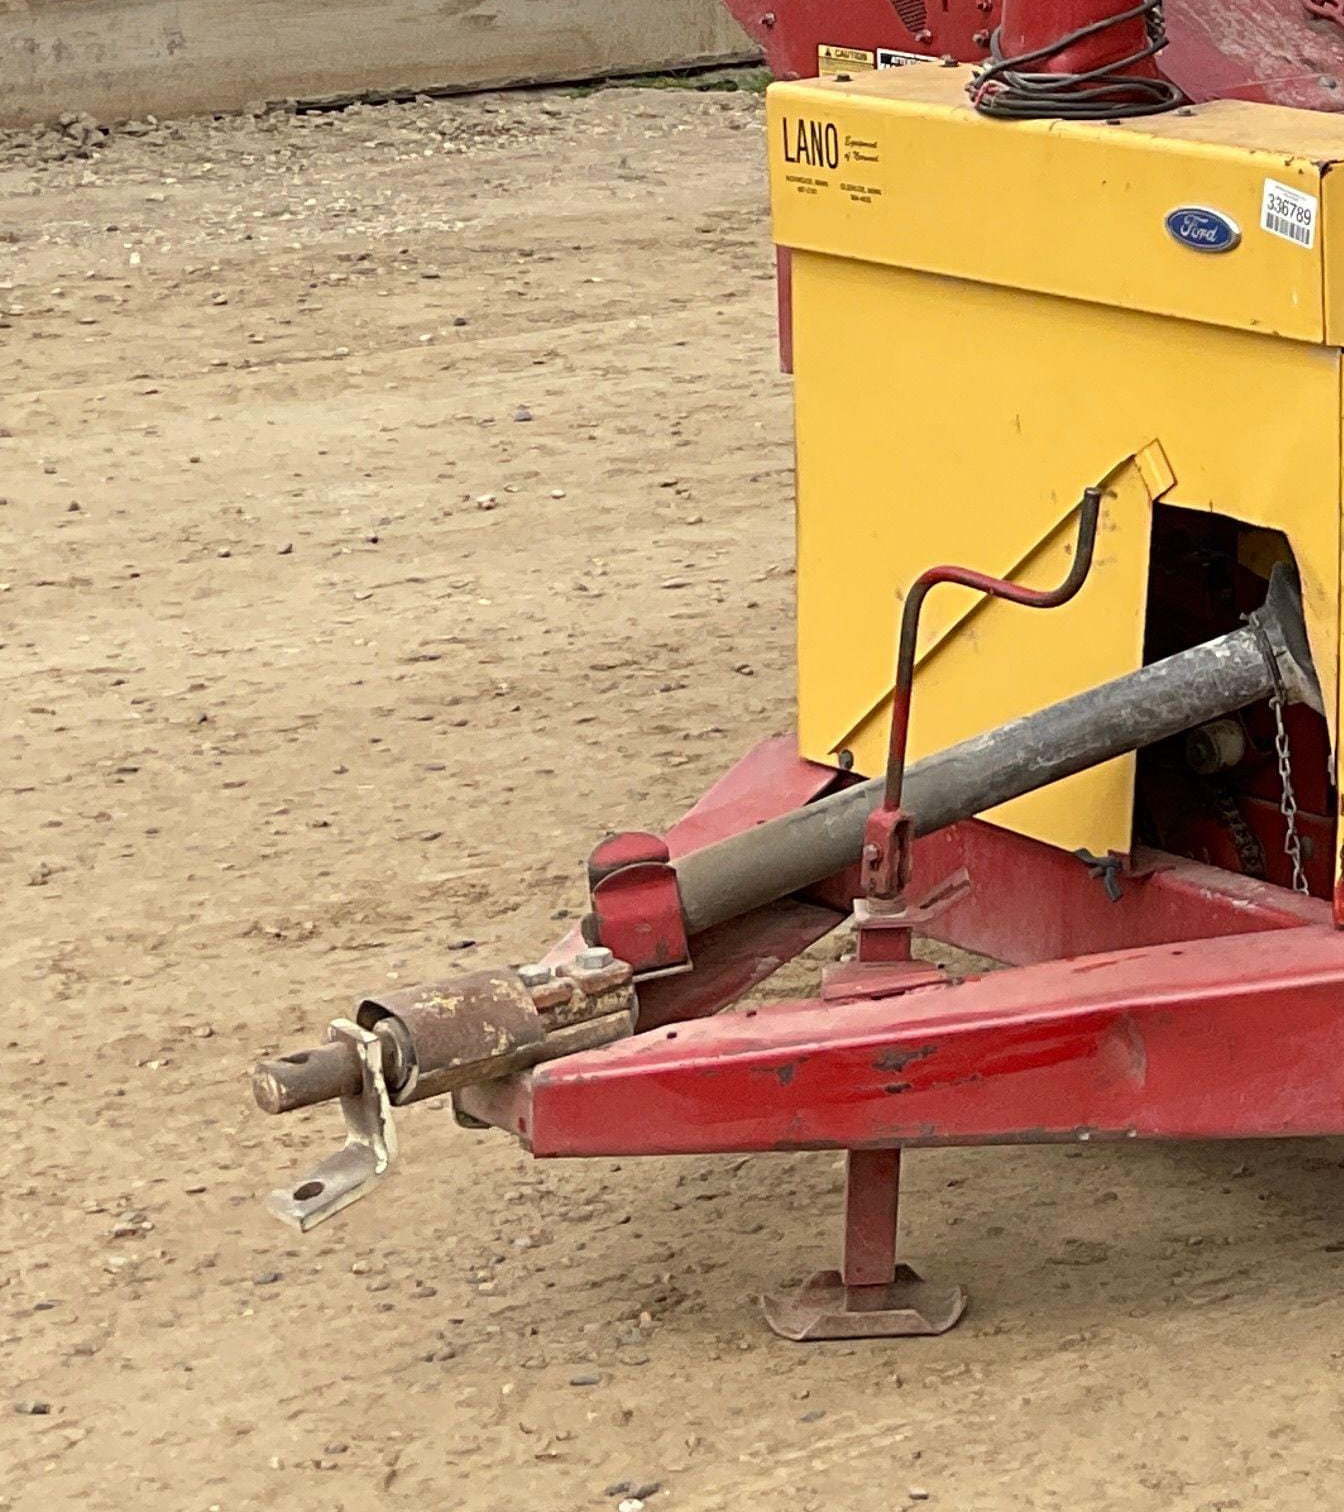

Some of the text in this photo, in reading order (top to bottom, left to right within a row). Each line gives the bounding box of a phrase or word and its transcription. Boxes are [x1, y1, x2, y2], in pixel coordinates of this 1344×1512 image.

[783, 117, 839, 170] LANO
[1267, 193, 1312, 226] 336789
[1180, 214, 1218, 243] Ford
